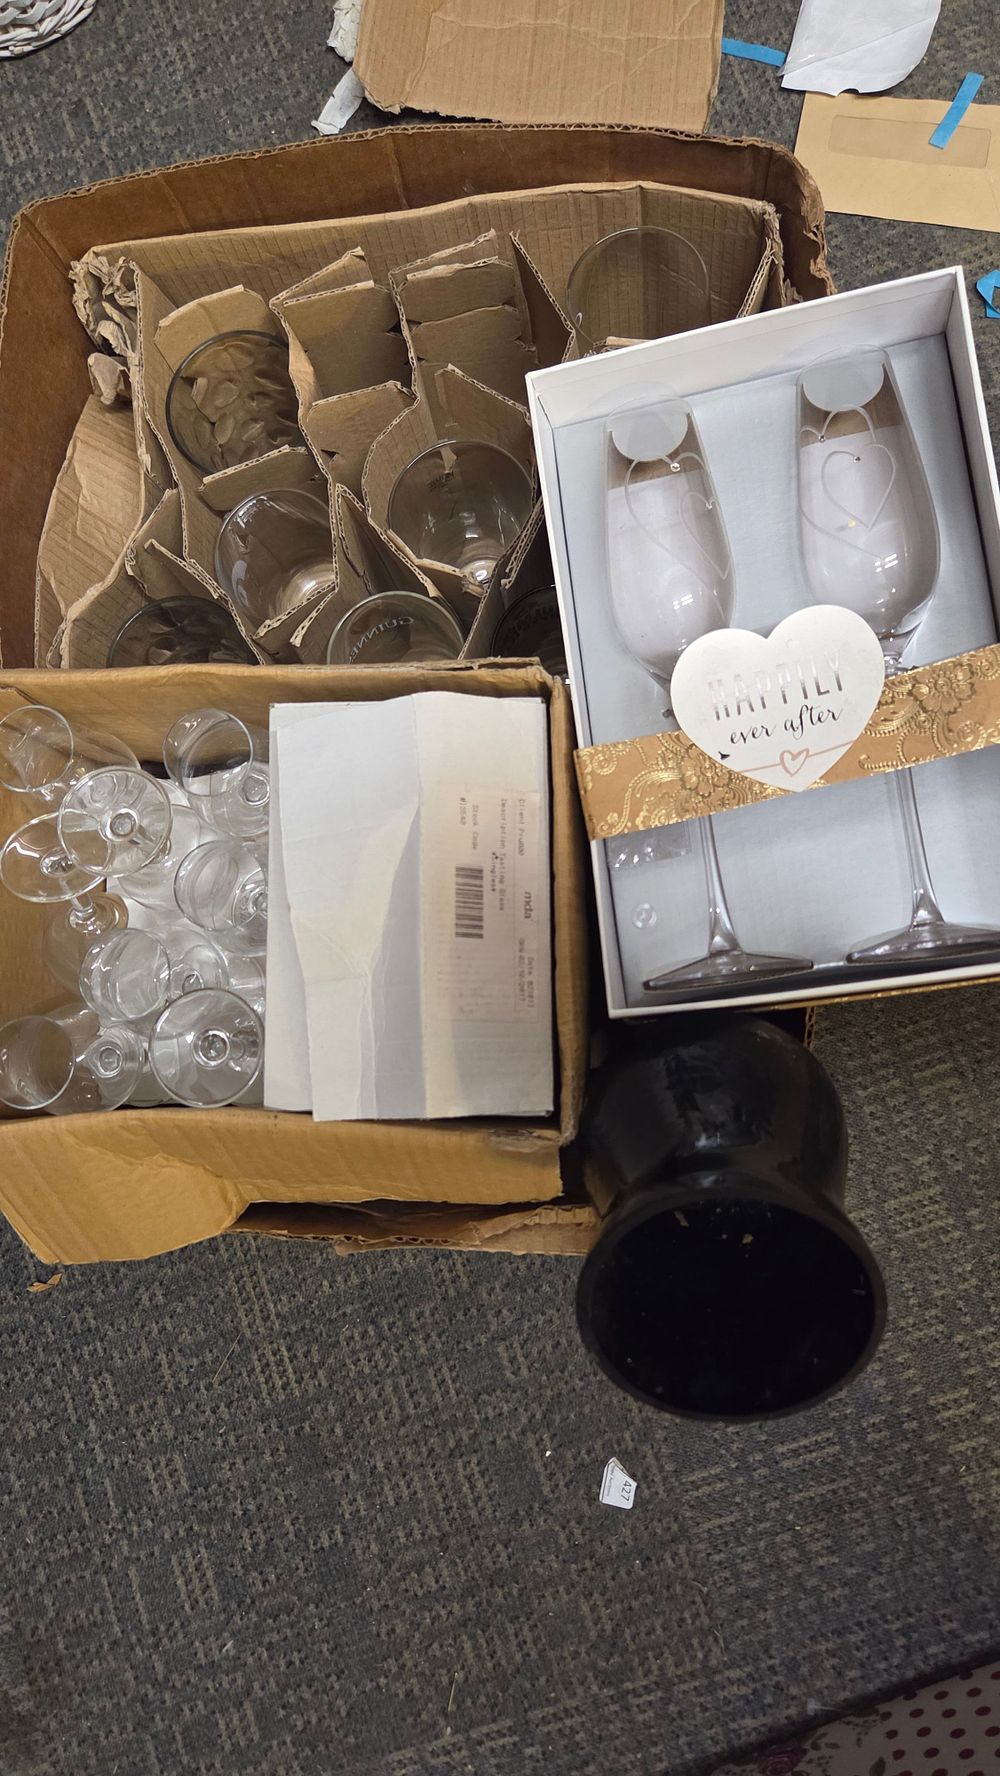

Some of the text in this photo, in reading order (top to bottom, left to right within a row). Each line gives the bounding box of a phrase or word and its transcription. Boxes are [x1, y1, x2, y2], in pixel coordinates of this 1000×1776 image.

[707, 650, 844, 722] HAPPILY
[729, 703, 844, 746] ever after
[499, 799, 507, 849] Description
[524, 891, 534, 920] mda
[621, 1480, 632, 1501] 427
